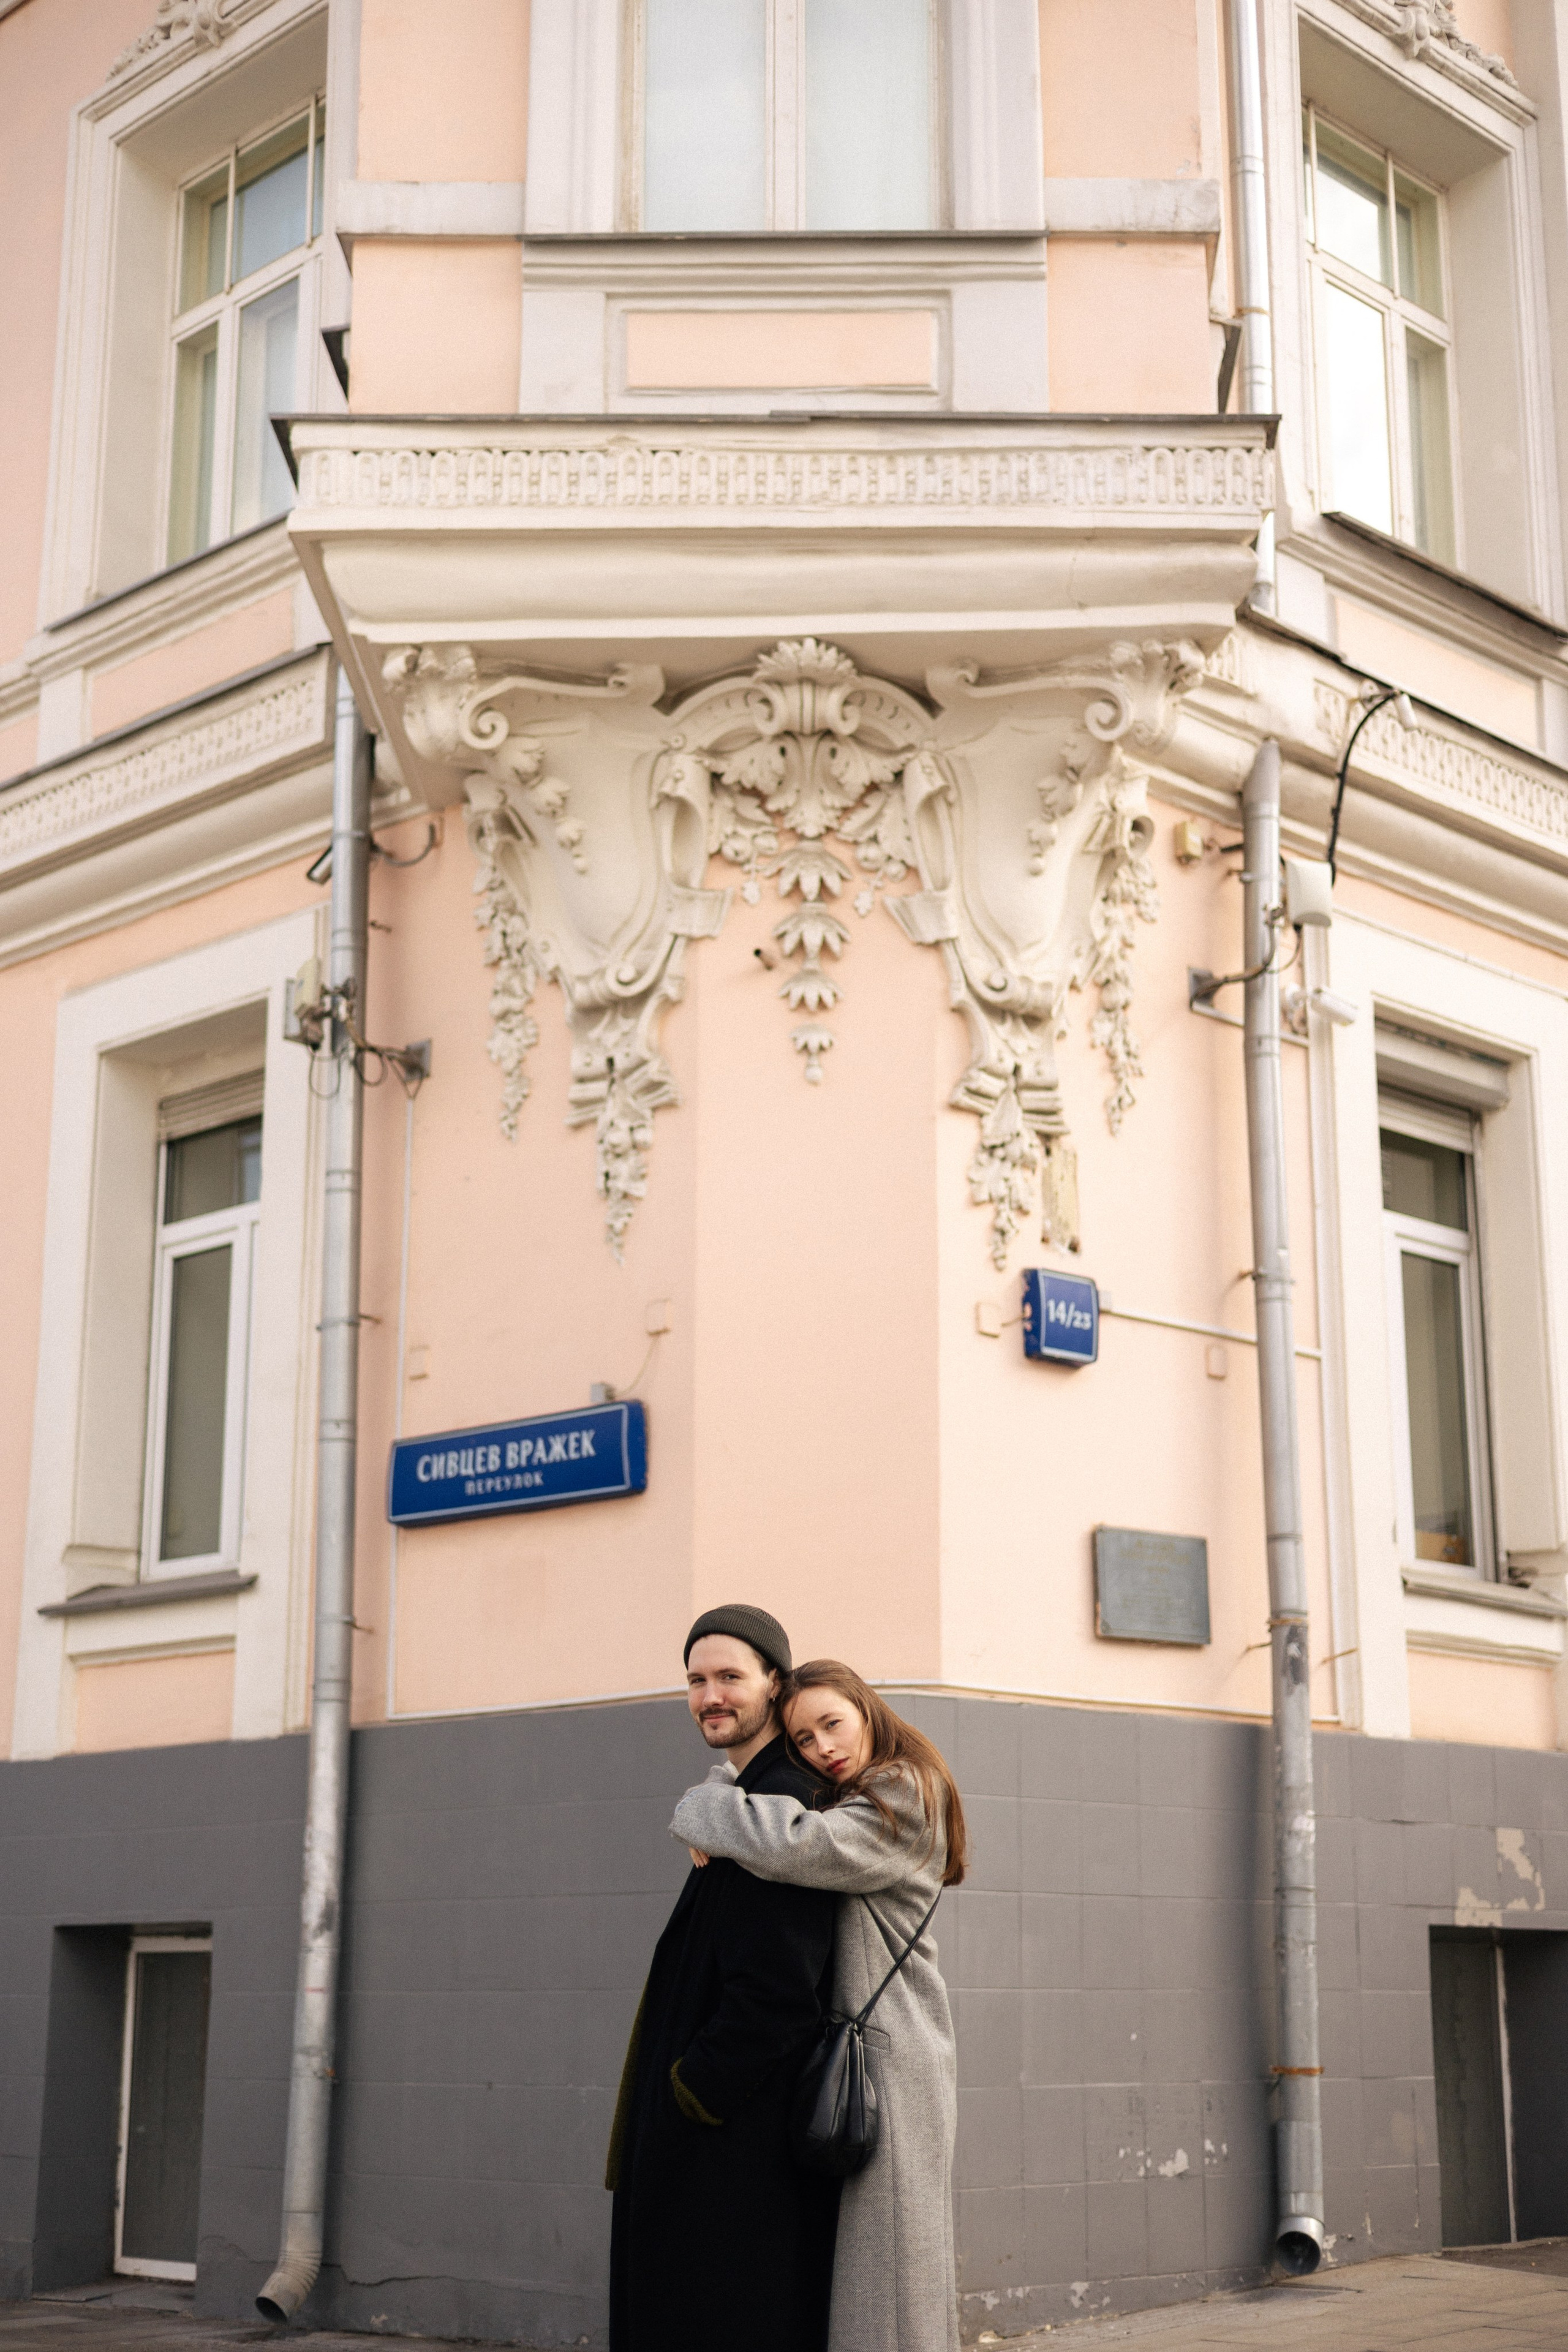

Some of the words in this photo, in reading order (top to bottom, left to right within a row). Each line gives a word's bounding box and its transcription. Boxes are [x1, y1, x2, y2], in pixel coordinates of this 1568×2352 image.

[417, 1444, 501, 1482] СИВЦЕВ
[505, 1429, 596, 1469] ВРАЖЕК
[464, 1471, 544, 1496] ПЕРЕУЛОК
